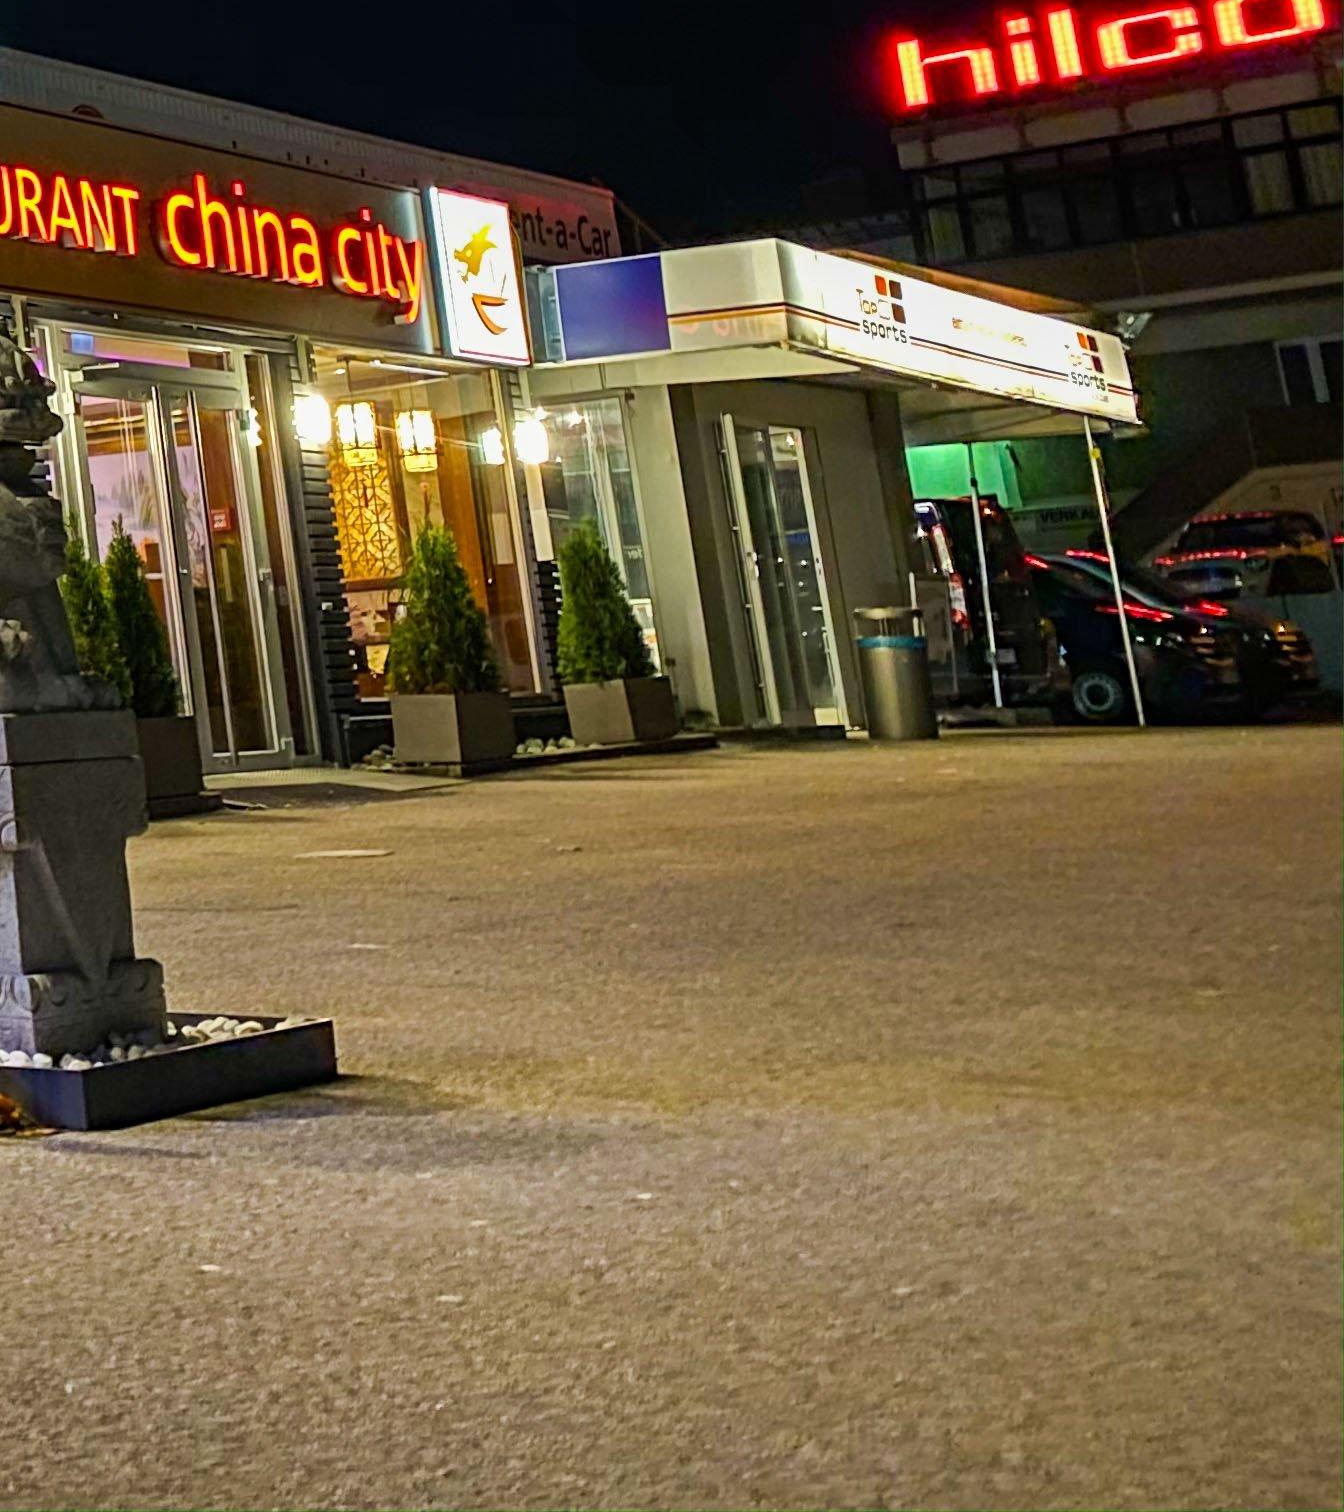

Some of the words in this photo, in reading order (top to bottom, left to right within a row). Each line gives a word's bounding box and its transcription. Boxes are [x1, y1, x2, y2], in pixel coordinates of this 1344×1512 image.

[164, 173, 324, 288] china
[335, 207, 424, 324] city
[862, 318, 907, 344] sports
[1070, 370, 1106, 392] sports
